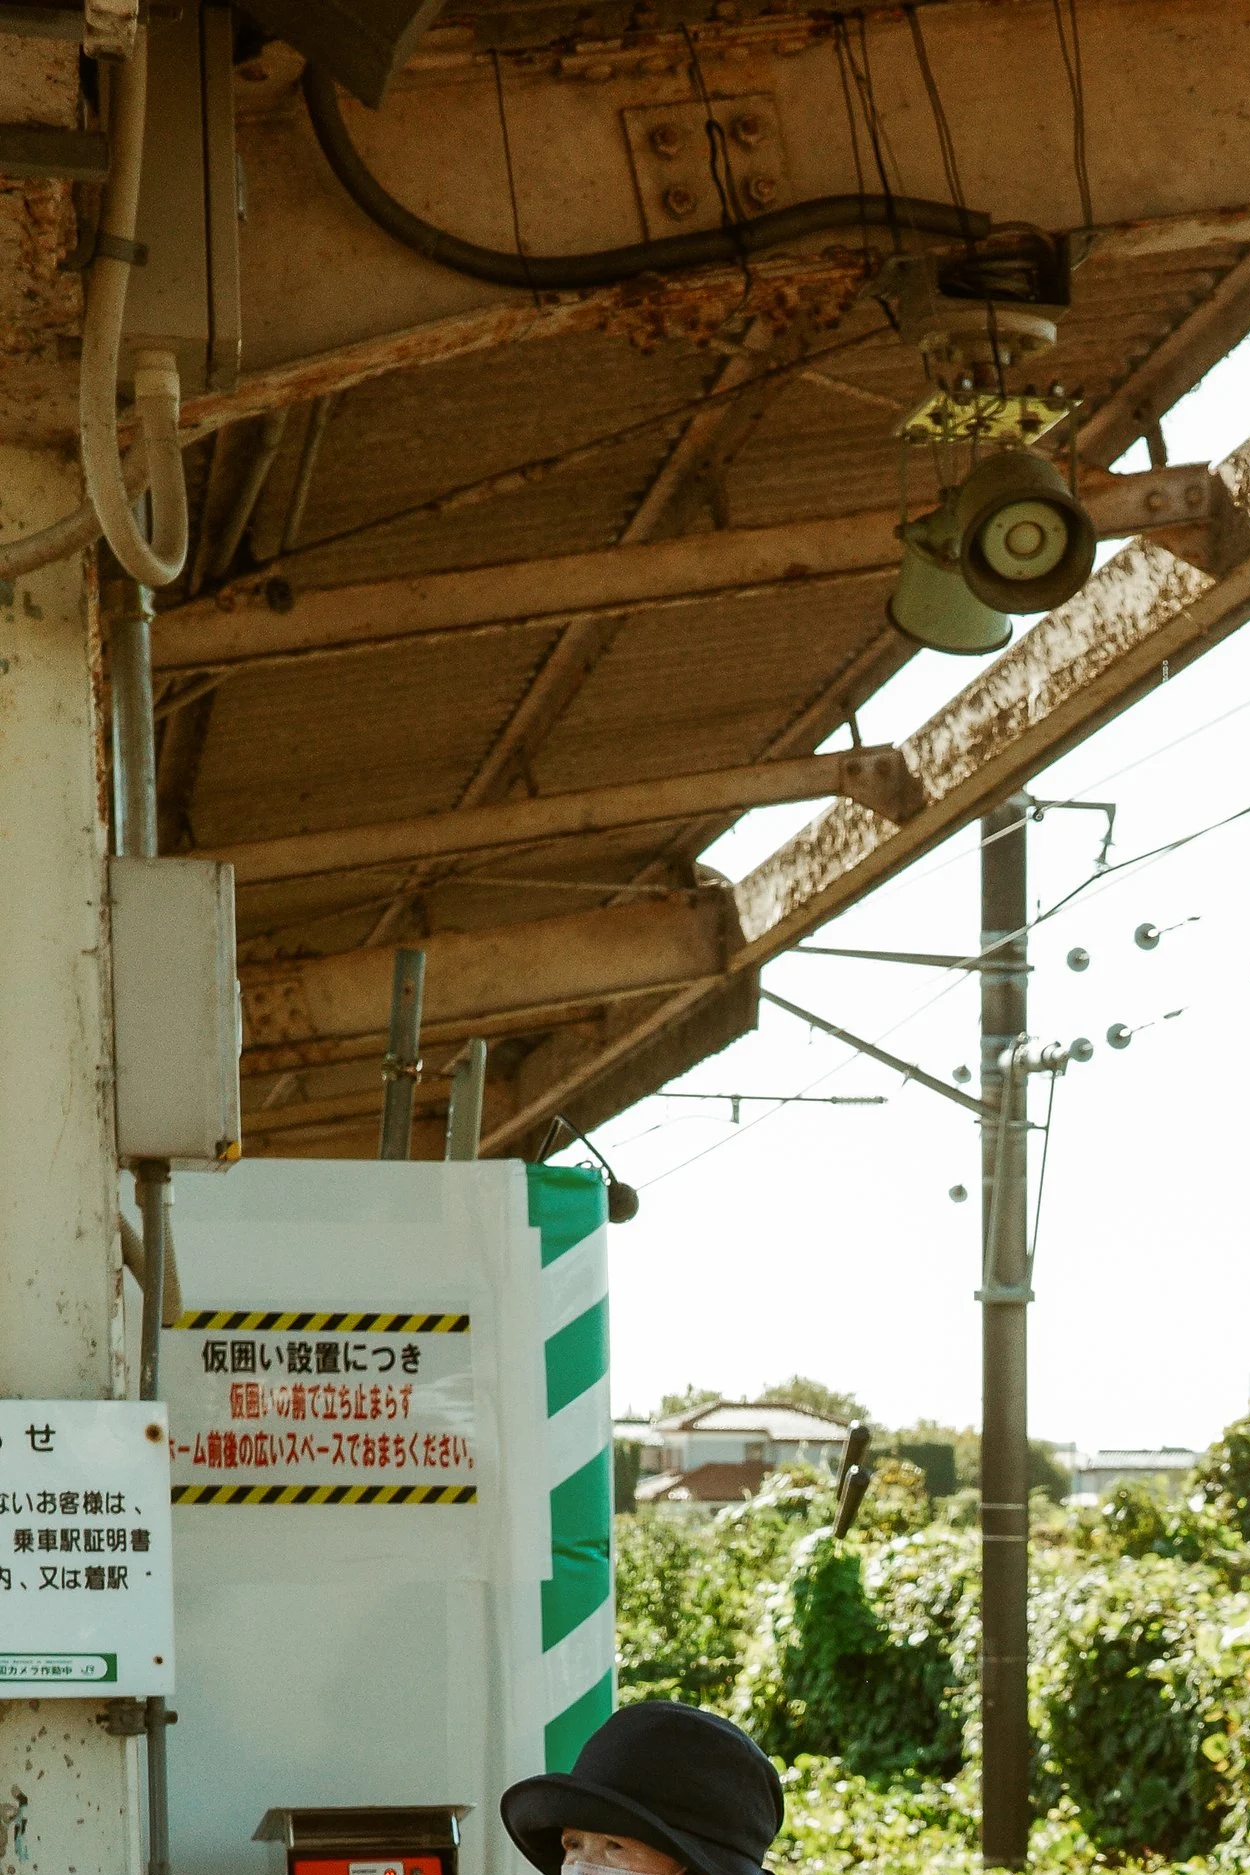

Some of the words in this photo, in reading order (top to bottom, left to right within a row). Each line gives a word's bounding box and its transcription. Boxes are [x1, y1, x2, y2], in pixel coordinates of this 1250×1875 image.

[202, 1340, 421, 1374] 仮囲い設置につき
[229, 1382, 413, 1420] 仮囲いの前で立ち止まらず
[25, 1423, 56, 1452] せ
[14, 1528, 151, 1553] 乗車駅証明書
